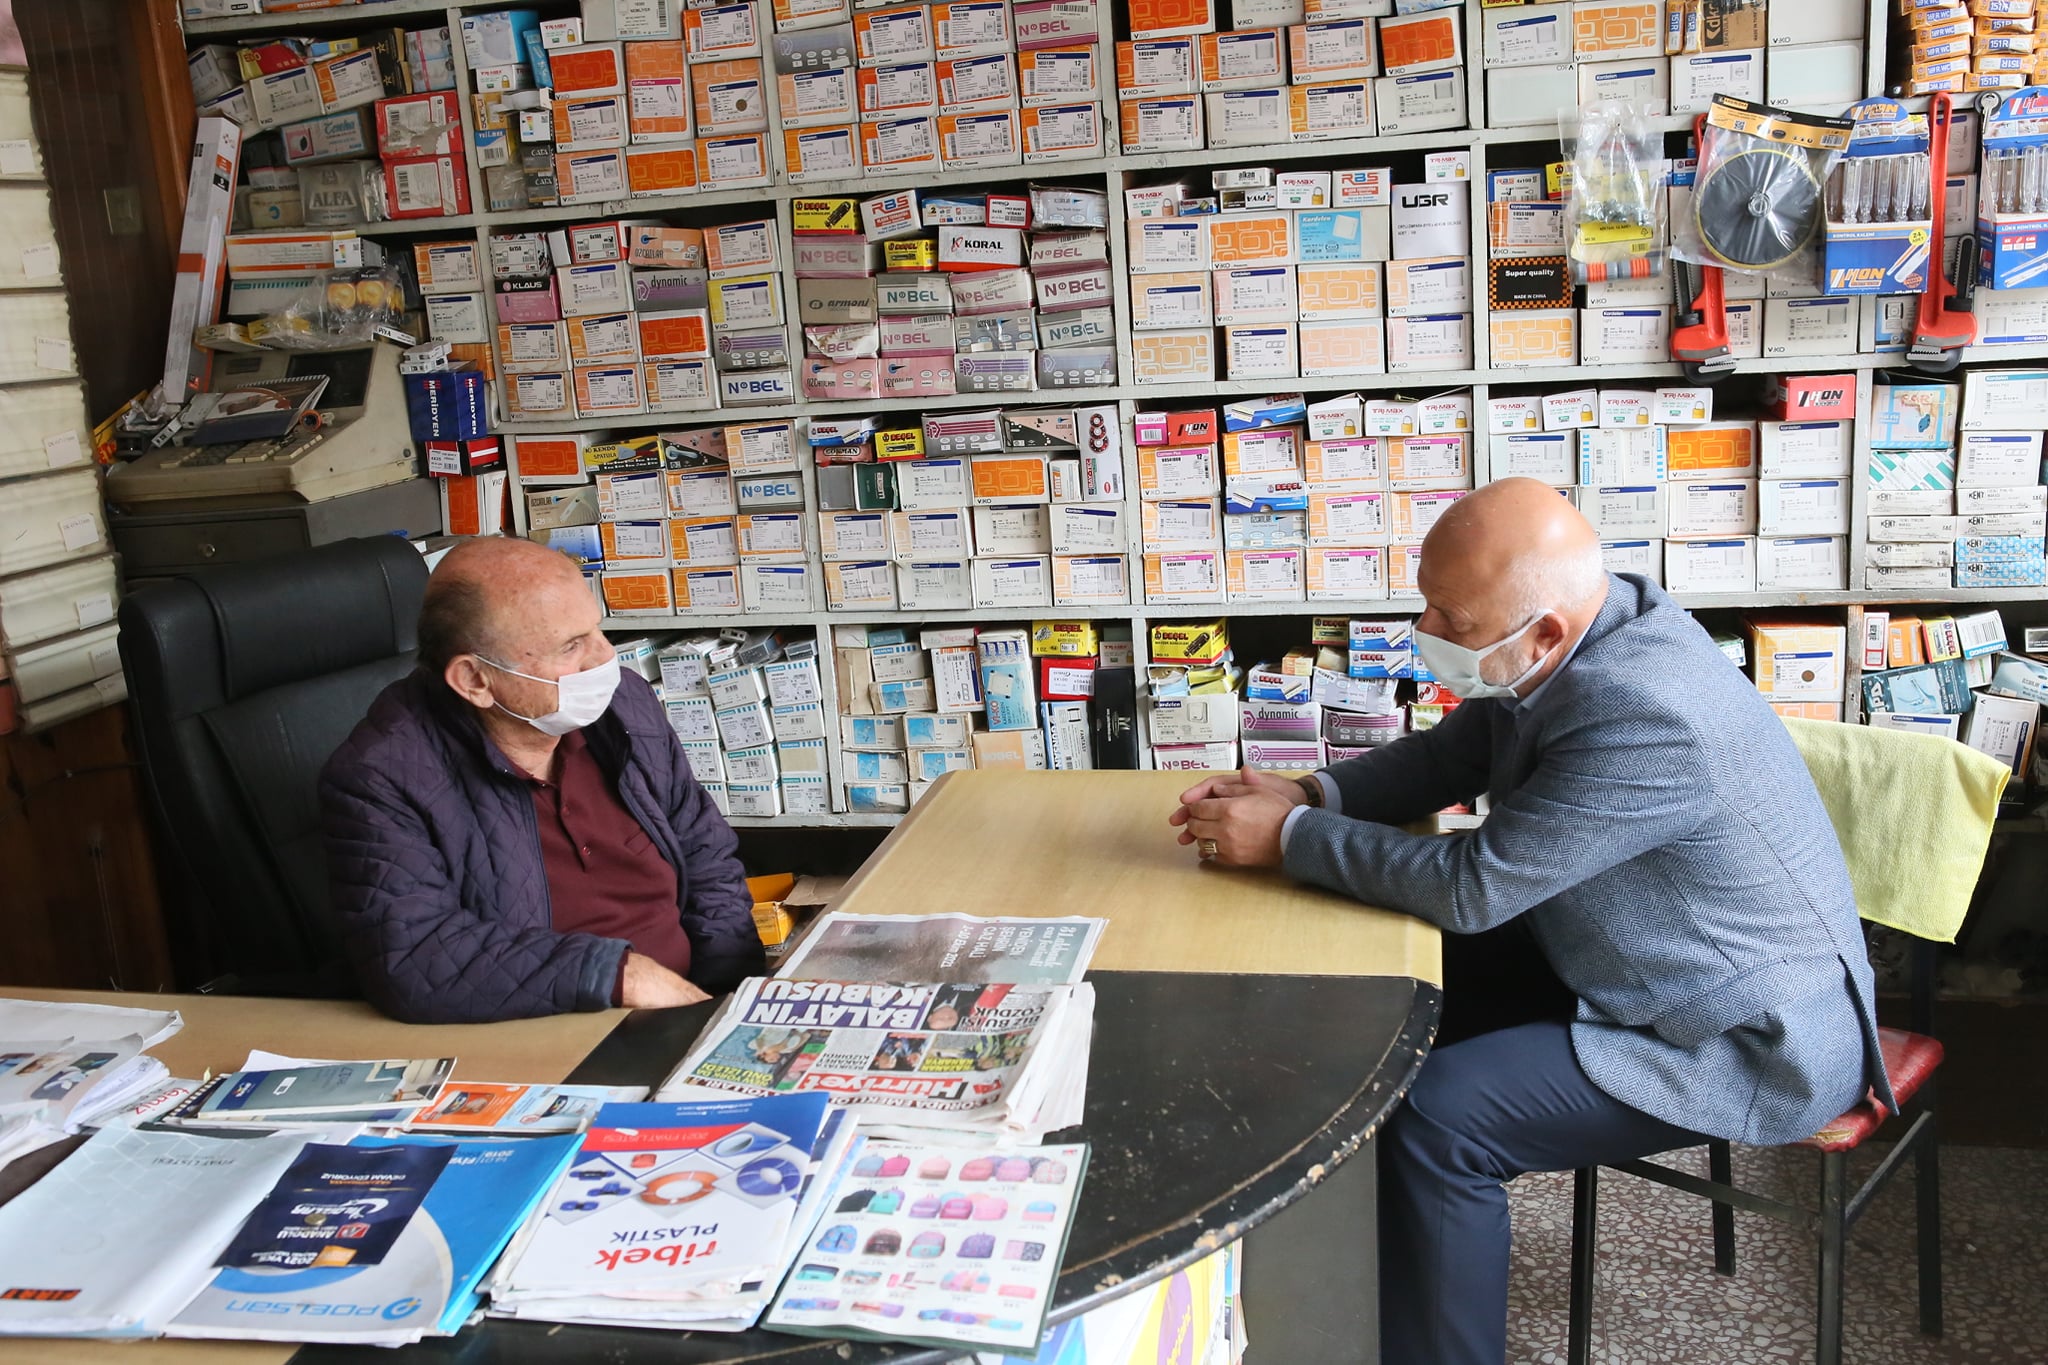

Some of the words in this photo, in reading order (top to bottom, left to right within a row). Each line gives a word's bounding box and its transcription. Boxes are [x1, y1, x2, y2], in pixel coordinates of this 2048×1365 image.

[1990, 39, 2009, 48] 151R
[1980, 76, 1999, 86] 151R
[964, 239, 1004, 250] KORAL
[1505, 269, 1527, 278] Super
[1529, 268, 1555, 278] quality
[512, 281, 543, 289] KLAUS
[651, 274, 688, 289] dynamic
[1258, 708, 1299, 720] dynamic
[749, 1001, 920, 1029] BALAT'IN
[805, 1073, 963, 1099] Hürriyet
[277, 1229, 338, 1240] ANADOLU
[610, 1223, 719, 1244] PLASTİK
[594, 1240, 719, 1271] ribek
